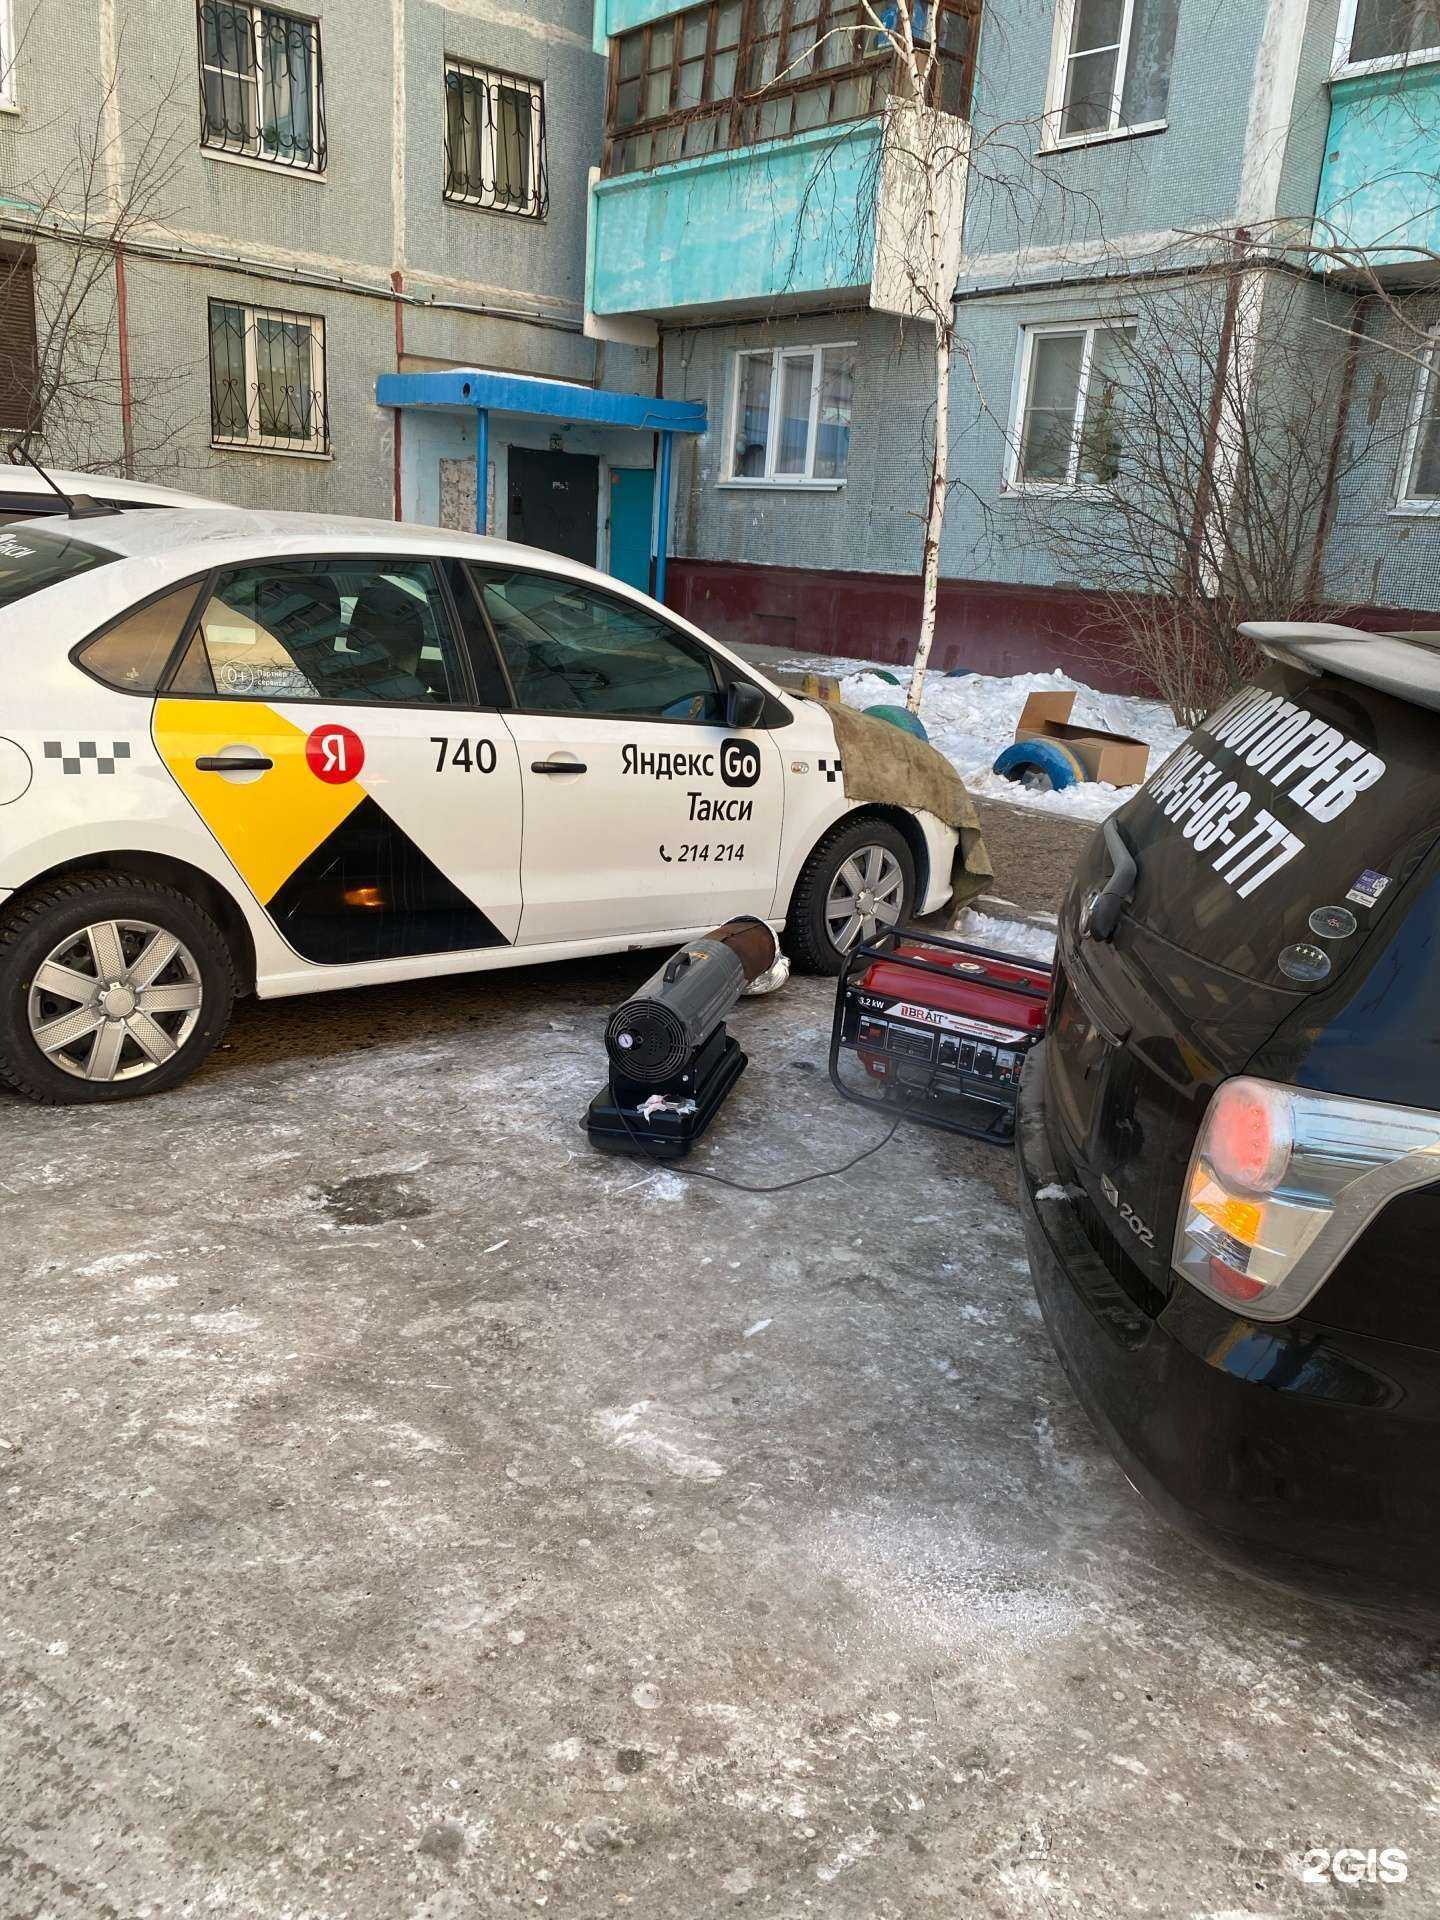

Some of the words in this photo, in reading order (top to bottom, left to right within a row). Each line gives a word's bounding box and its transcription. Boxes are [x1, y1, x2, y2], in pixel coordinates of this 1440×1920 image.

[321, 734, 347, 772] Я
[430, 737, 497, 774] 740
[621, 743, 714, 780] Яндекс
[724, 745, 757, 779] Go
[687, 791, 753, 822] Такси
[678, 845, 708, 862] 214
[714, 844, 745, 861] 214
[859, 996, 871, 1006] 3.2
[872, 999, 884, 1009] kW
[908, 1007, 945, 1025] BRAIT
[1119, 1202, 1155, 1249] 202
